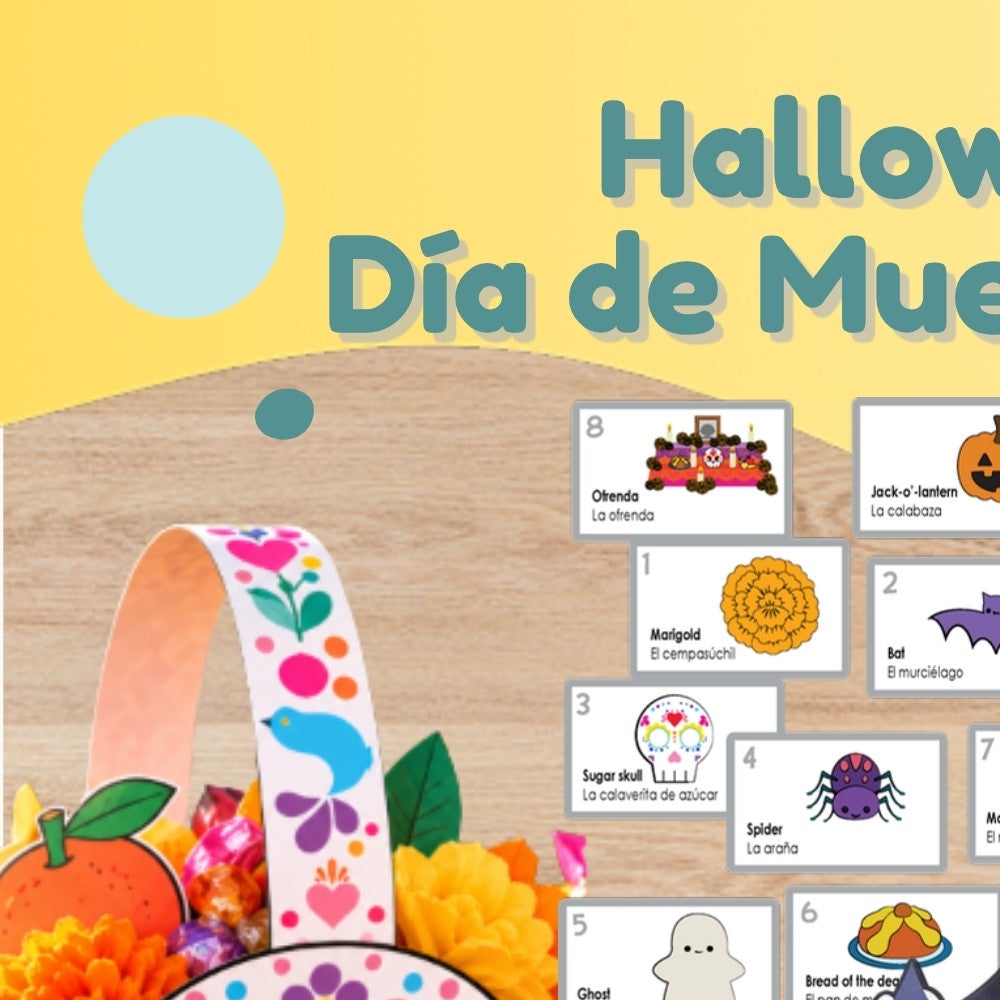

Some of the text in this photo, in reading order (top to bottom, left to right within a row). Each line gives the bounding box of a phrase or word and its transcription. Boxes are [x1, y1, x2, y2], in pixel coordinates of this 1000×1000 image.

[586, 415, 604, 438] 8
[592, 489, 639, 502] Ofrenda
[871, 485, 957, 498] Jack-o'-lantern
[592, 508, 654, 522] La ofrenda
[871, 504, 942, 517] La calabaza
[643, 553, 649, 575] 1
[883, 571, 897, 594] 2
[650, 628, 701, 643] Marigold
[651, 647, 736, 662] El cempasúchil
[888, 647, 905, 659] Bat
[888, 665, 964, 681] El murciélago
[577, 693, 590, 715] 3
[981, 738, 994, 760] 7
[743, 746, 756, 769] 4
[583, 769, 642, 785] Sugar skull
[583, 788, 718, 801] La calaverita de azúcar
[747, 822, 783, 838] Spider
[987, 830, 995, 843] El
[747, 842, 798, 855] La araña
[801, 901, 818, 923] 6
[573, 914, 587, 936] 5
[806, 974, 900, 988] Bread of the dea
[577, 987, 610, 1000] Ghost
